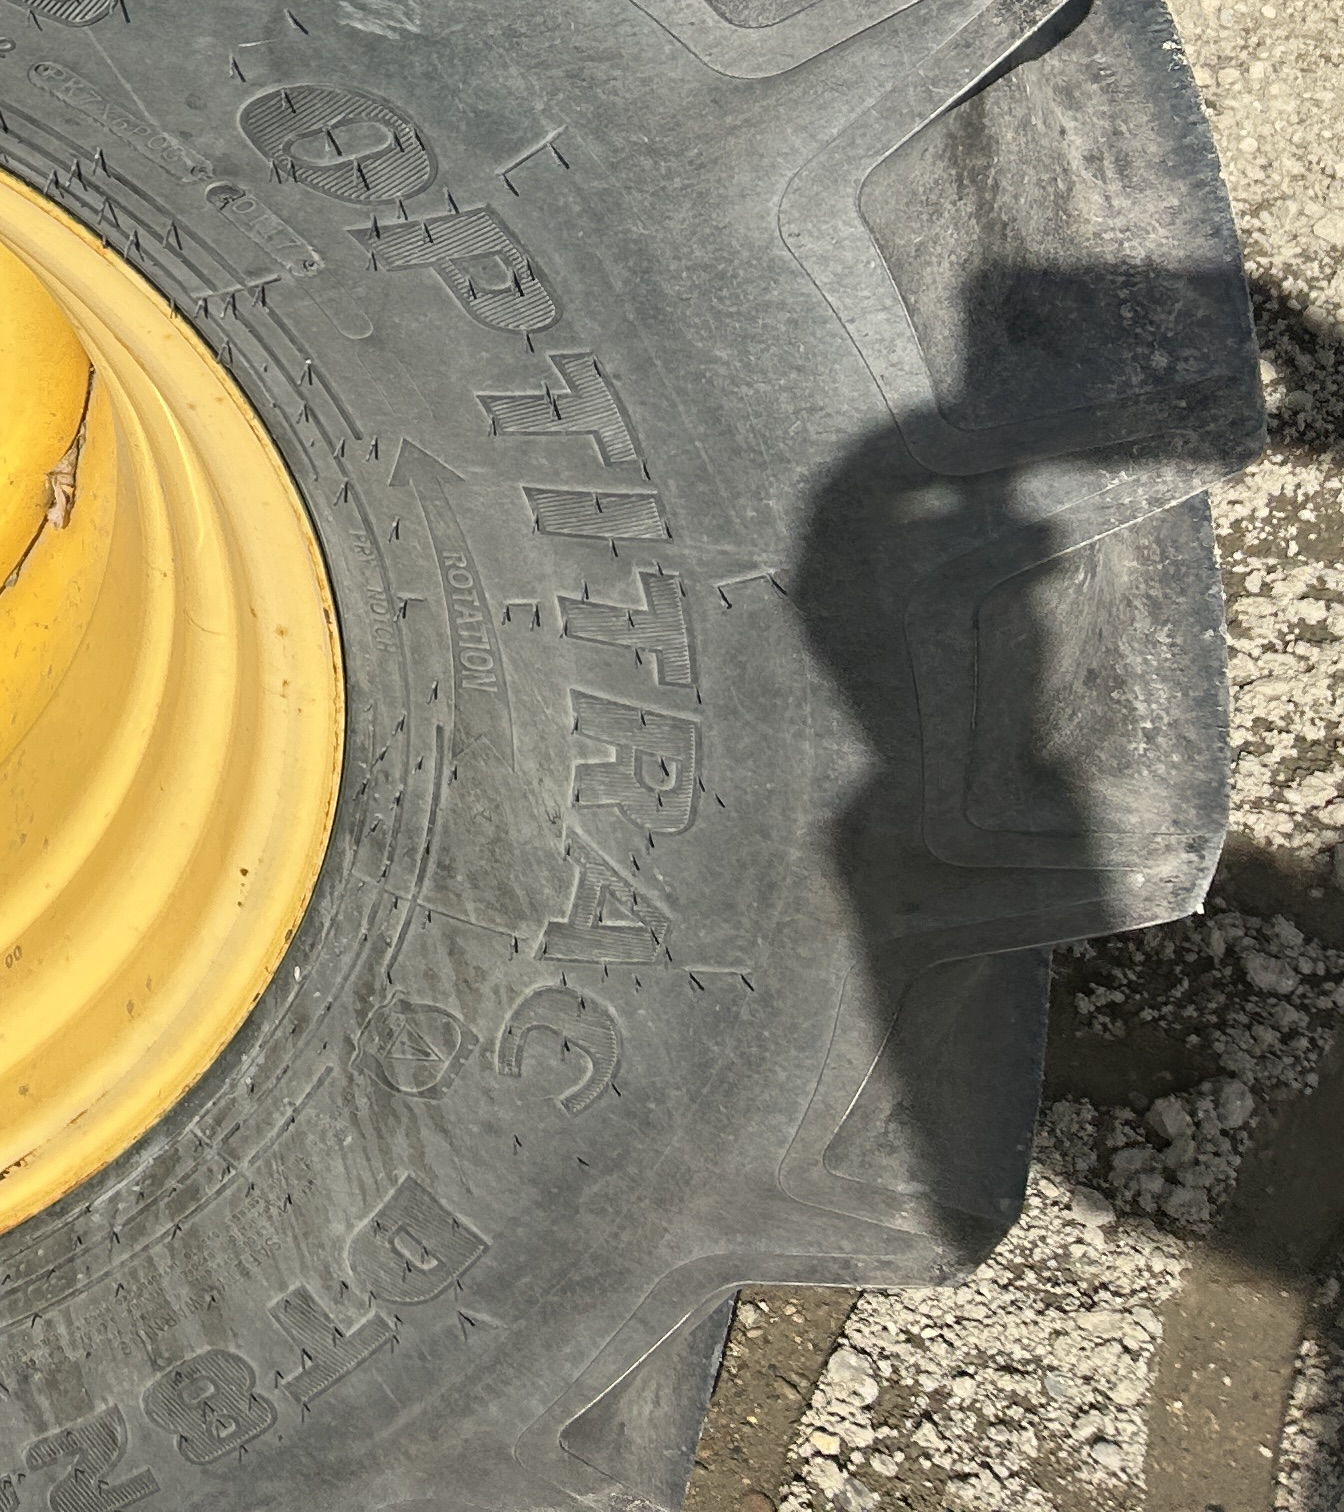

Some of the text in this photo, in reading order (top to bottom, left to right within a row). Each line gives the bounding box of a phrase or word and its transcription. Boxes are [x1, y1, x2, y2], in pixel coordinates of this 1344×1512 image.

[235, 83, 708, 1117] OPTITRAC
[442, 549, 499, 693] ROTATION
[4, 944, 23, 970] 00
